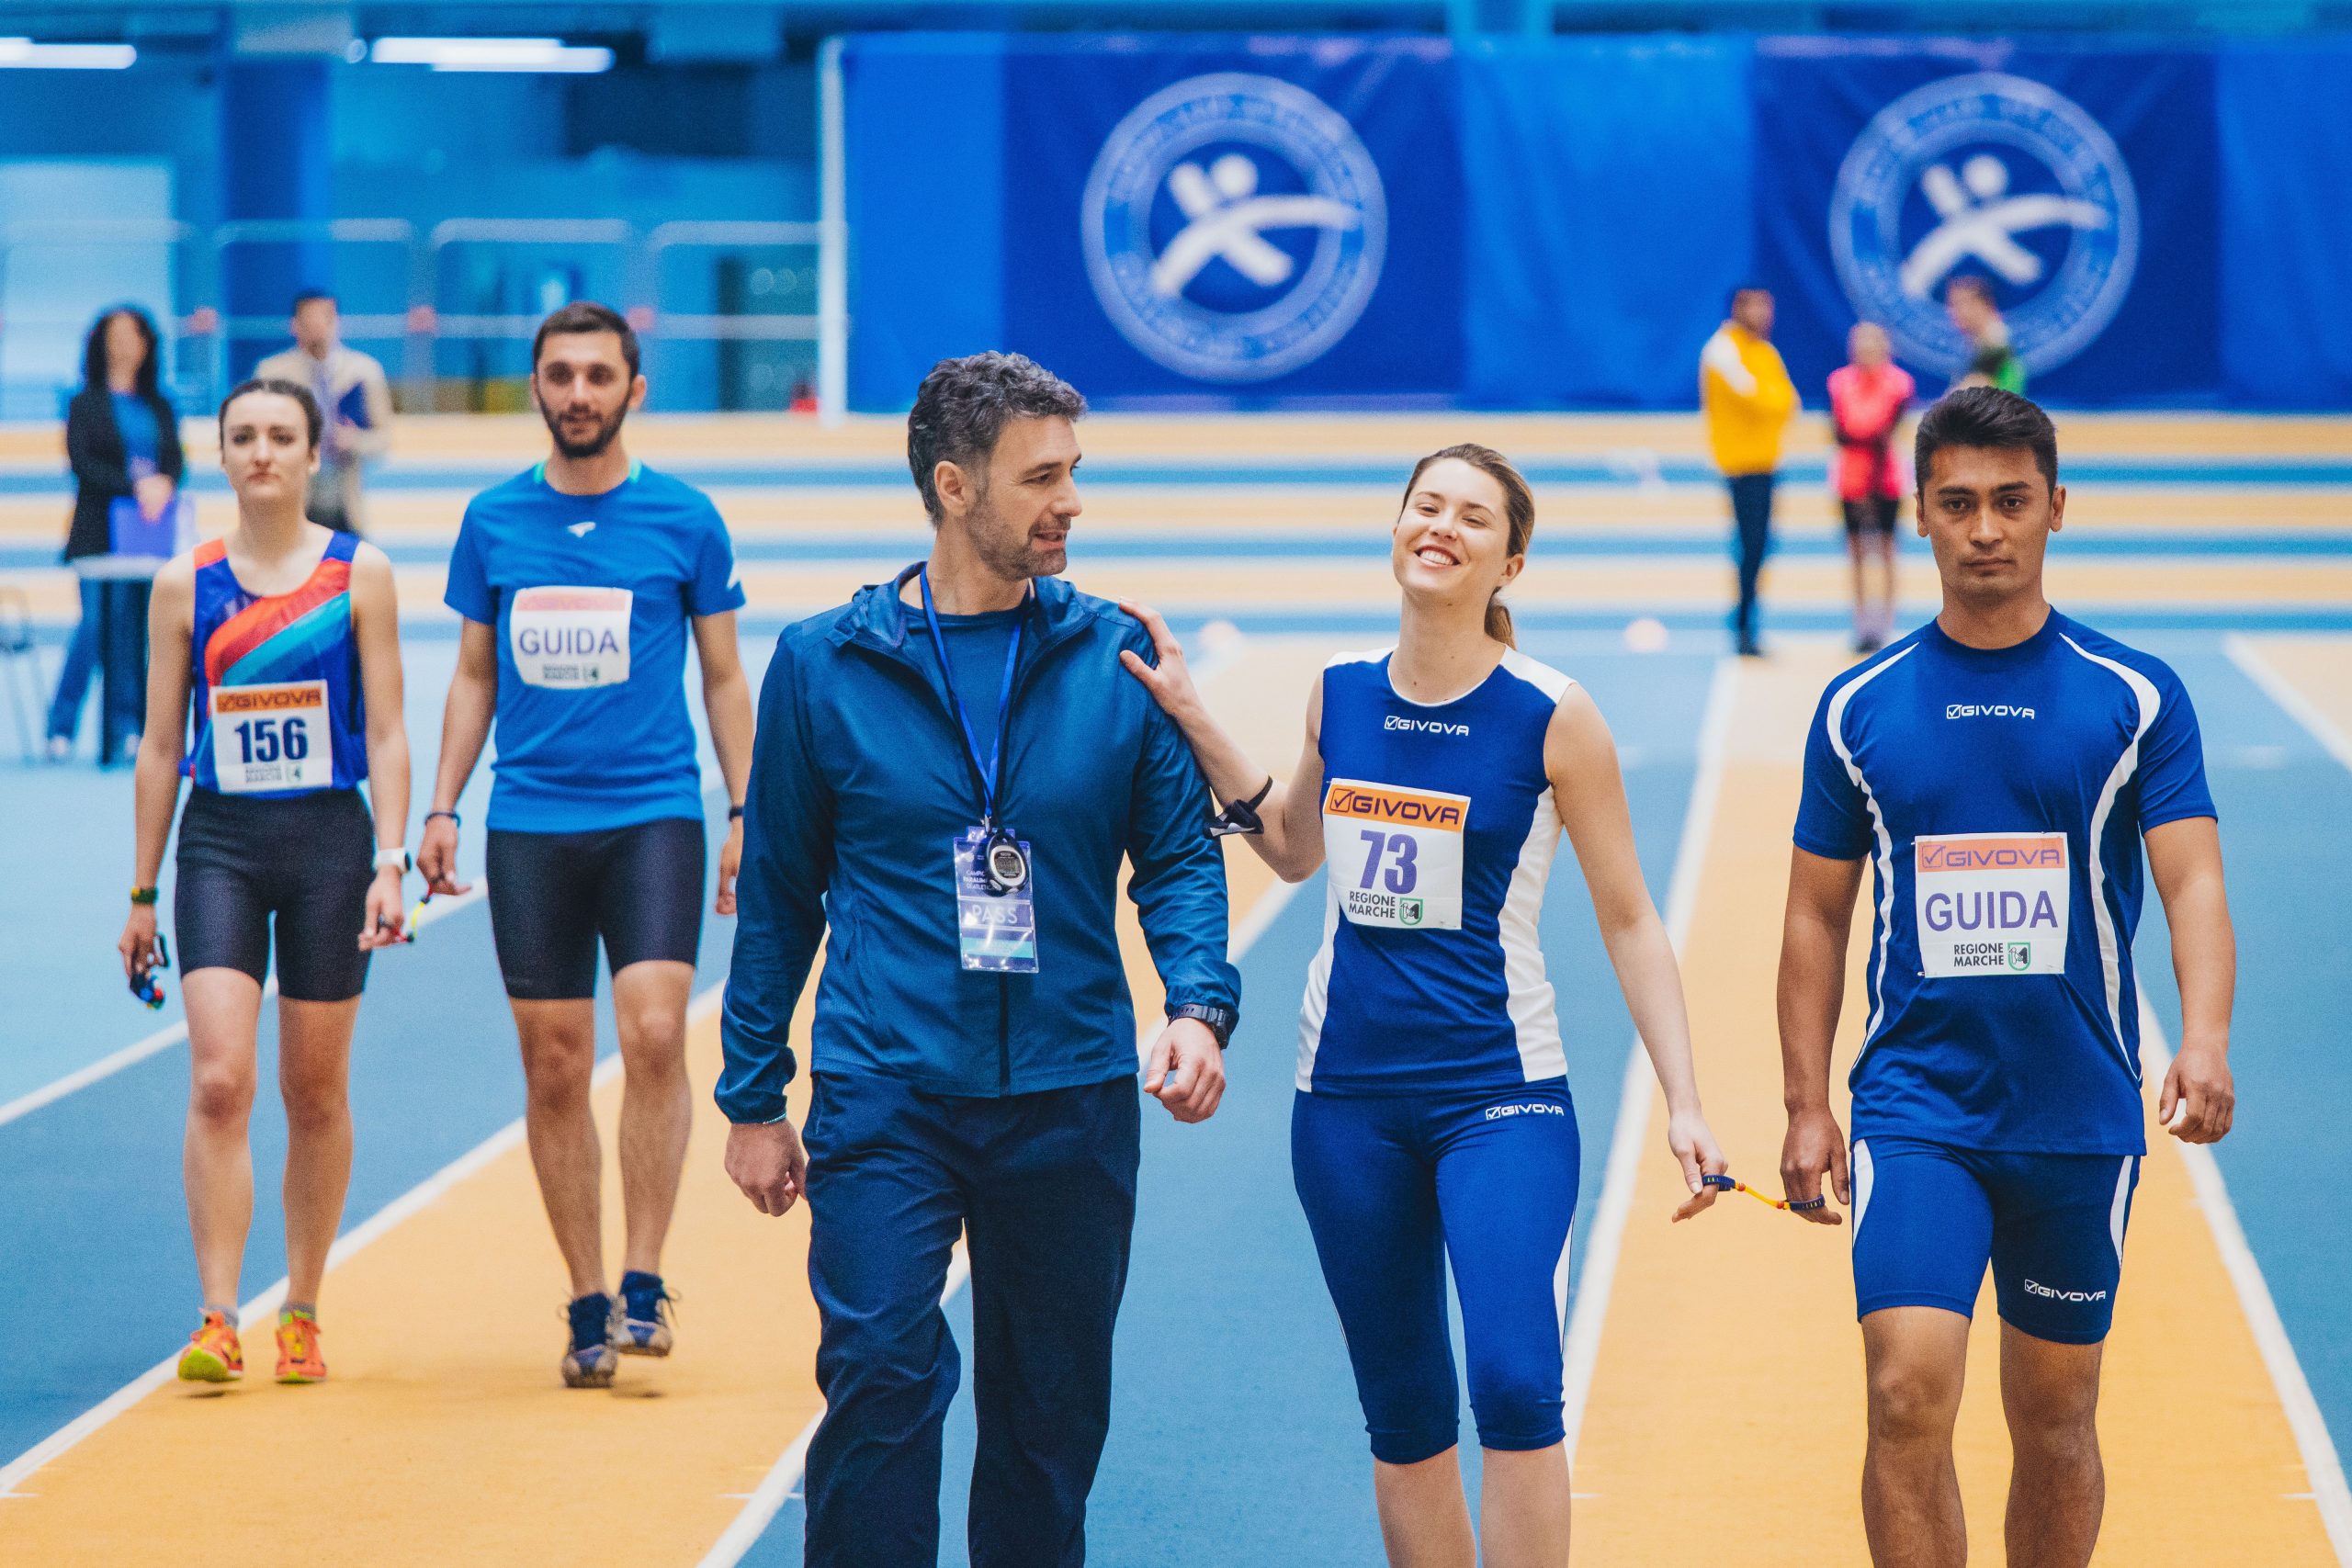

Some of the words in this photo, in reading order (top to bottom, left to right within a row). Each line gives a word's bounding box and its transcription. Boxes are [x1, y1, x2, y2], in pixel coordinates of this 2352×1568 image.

[518, 627, 619, 656] GUIDA
[235, 689, 321, 708] GIVOVA
[1961, 705, 2035, 719] GIVOVA
[1397, 718, 1469, 737] GIVOVA
[234, 716, 308, 763] 156
[1351, 795, 1460, 825] GIVOVA
[1359, 829, 1419, 895] 73
[1946, 849, 2060, 867] GIVOVA
[1349, 891, 1396, 907] REGIONE
[972, 904, 1018, 924] PASS
[1349, 903, 1396, 919] MARCHE
[1925, 890, 2058, 931] GUIDA
[1953, 942, 2004, 954] REGIONE
[1953, 955, 2004, 967] MARCHE
[1500, 1104, 1565, 1116] GIVOVA
[2037, 1286, 2106, 1302] GIVOVA
